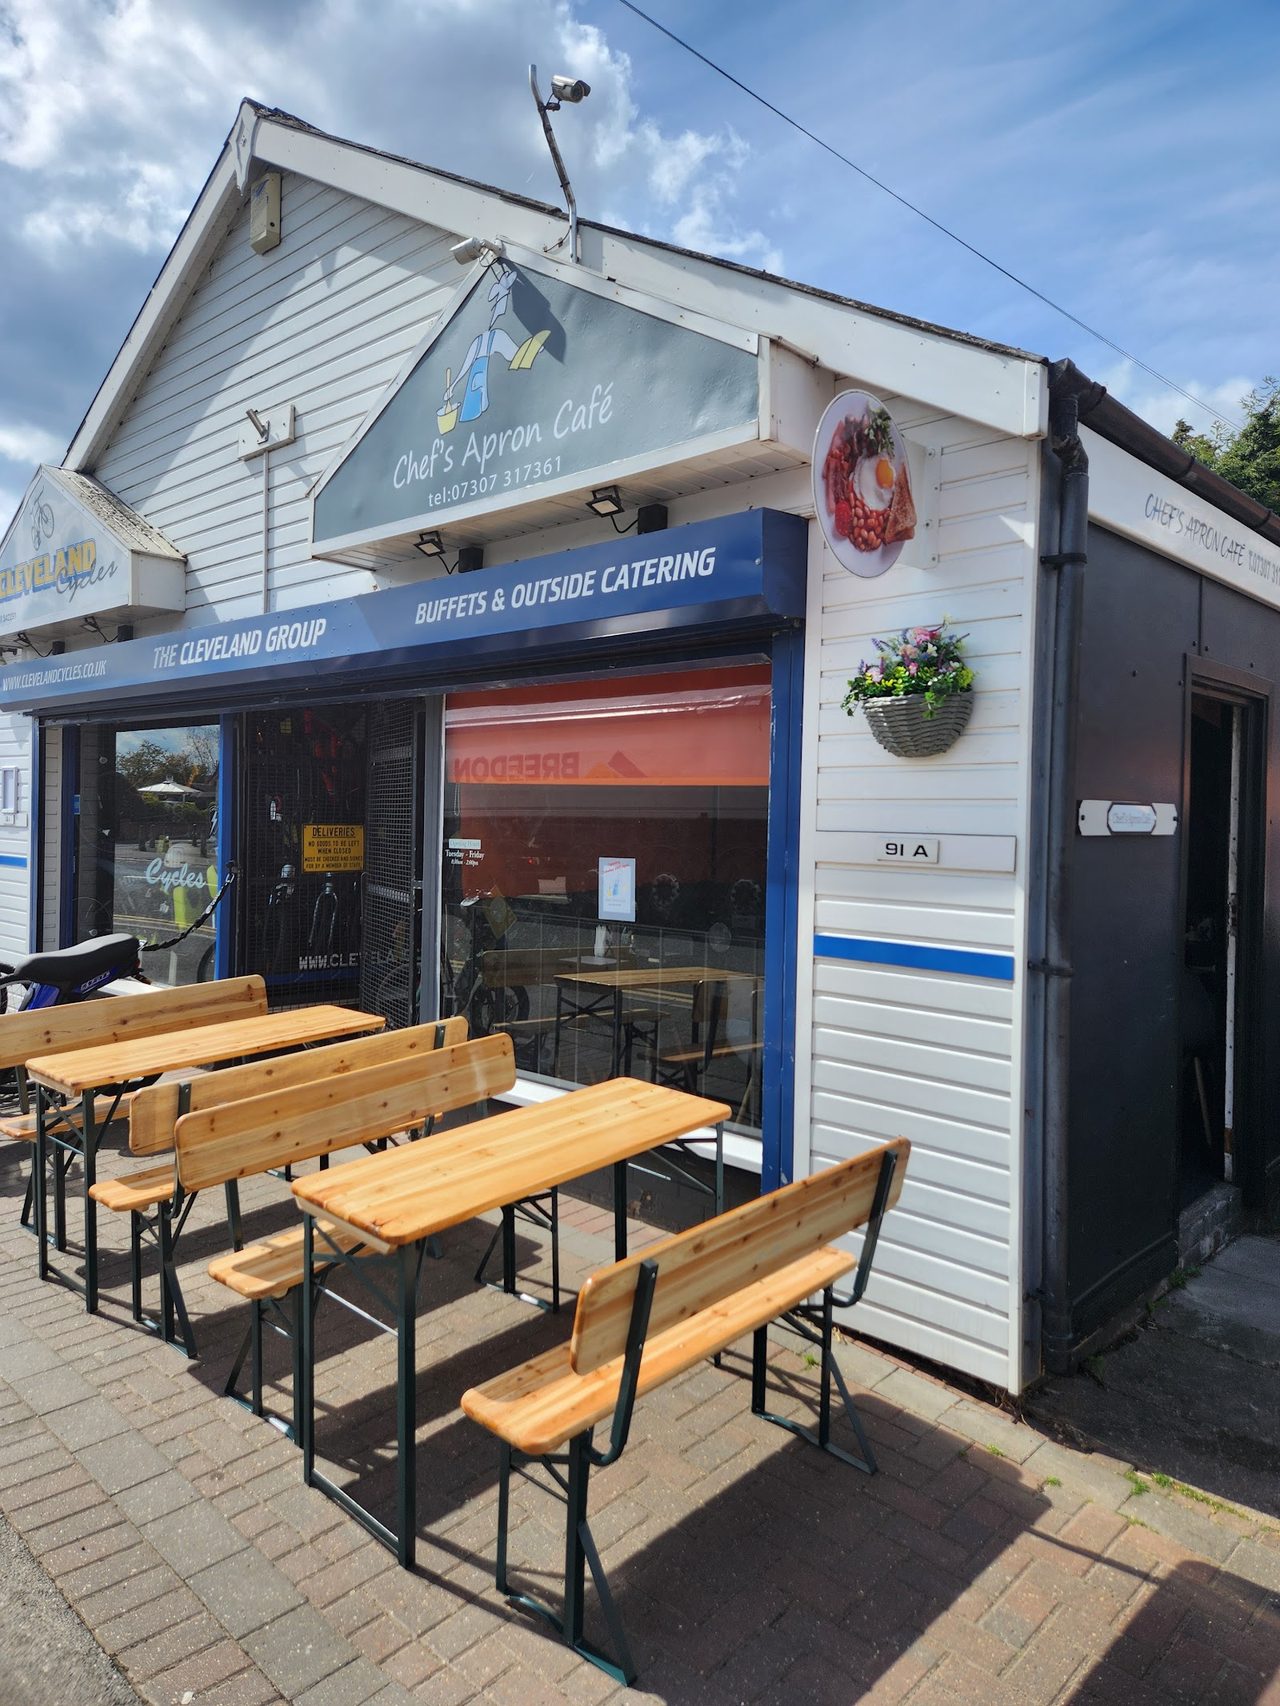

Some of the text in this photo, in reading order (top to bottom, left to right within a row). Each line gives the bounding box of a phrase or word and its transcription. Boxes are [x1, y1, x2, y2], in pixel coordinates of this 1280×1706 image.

[393, 381, 614, 489] Chef's Apron Café
[428, 455, 561, 507] tel:07307 317361
[1144, 493, 1185, 535] CHEF'S
[1184, 515, 1220, 553] APRON
[0, 538, 96, 602] CLEVELAND
[56, 560, 118, 603] Cycles
[415, 547, 716, 625] BUFFETS & OUTSIDE CATERING
[153, 618, 327, 669] THE CLEVELAND GROUP
[2, 660, 107, 692] WWW.CLEVELANDCYCLES.CO.UK
[312, 826, 356, 837] DELIVERIES
[885, 843, 929, 858] 91 A
[144, 857, 206, 895] Cycles
